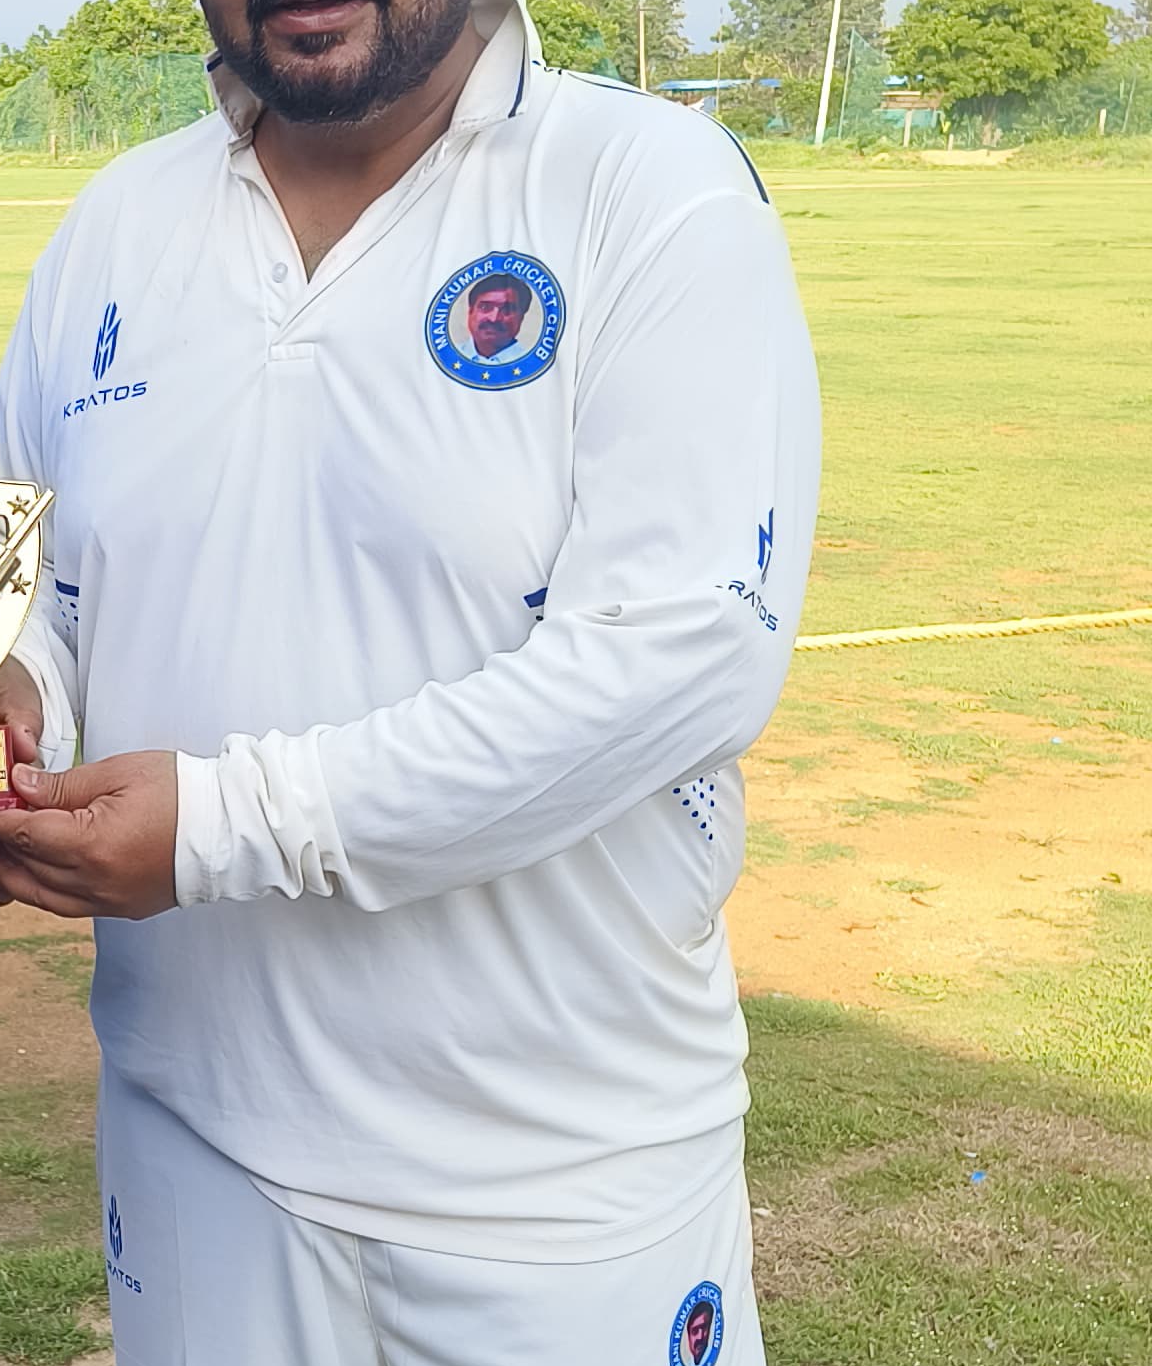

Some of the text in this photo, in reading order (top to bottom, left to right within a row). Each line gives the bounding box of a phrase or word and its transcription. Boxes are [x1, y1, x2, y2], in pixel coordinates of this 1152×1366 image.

[434, 257, 557, 361] MANI KUMAR CRICKET CLUB
[63, 381, 148, 421] KRATOS
[715, 580, 779, 631] RATOS
[106, 1259, 143, 1294] RATOS
[675, 1296, 697, 1340] KUMAR
